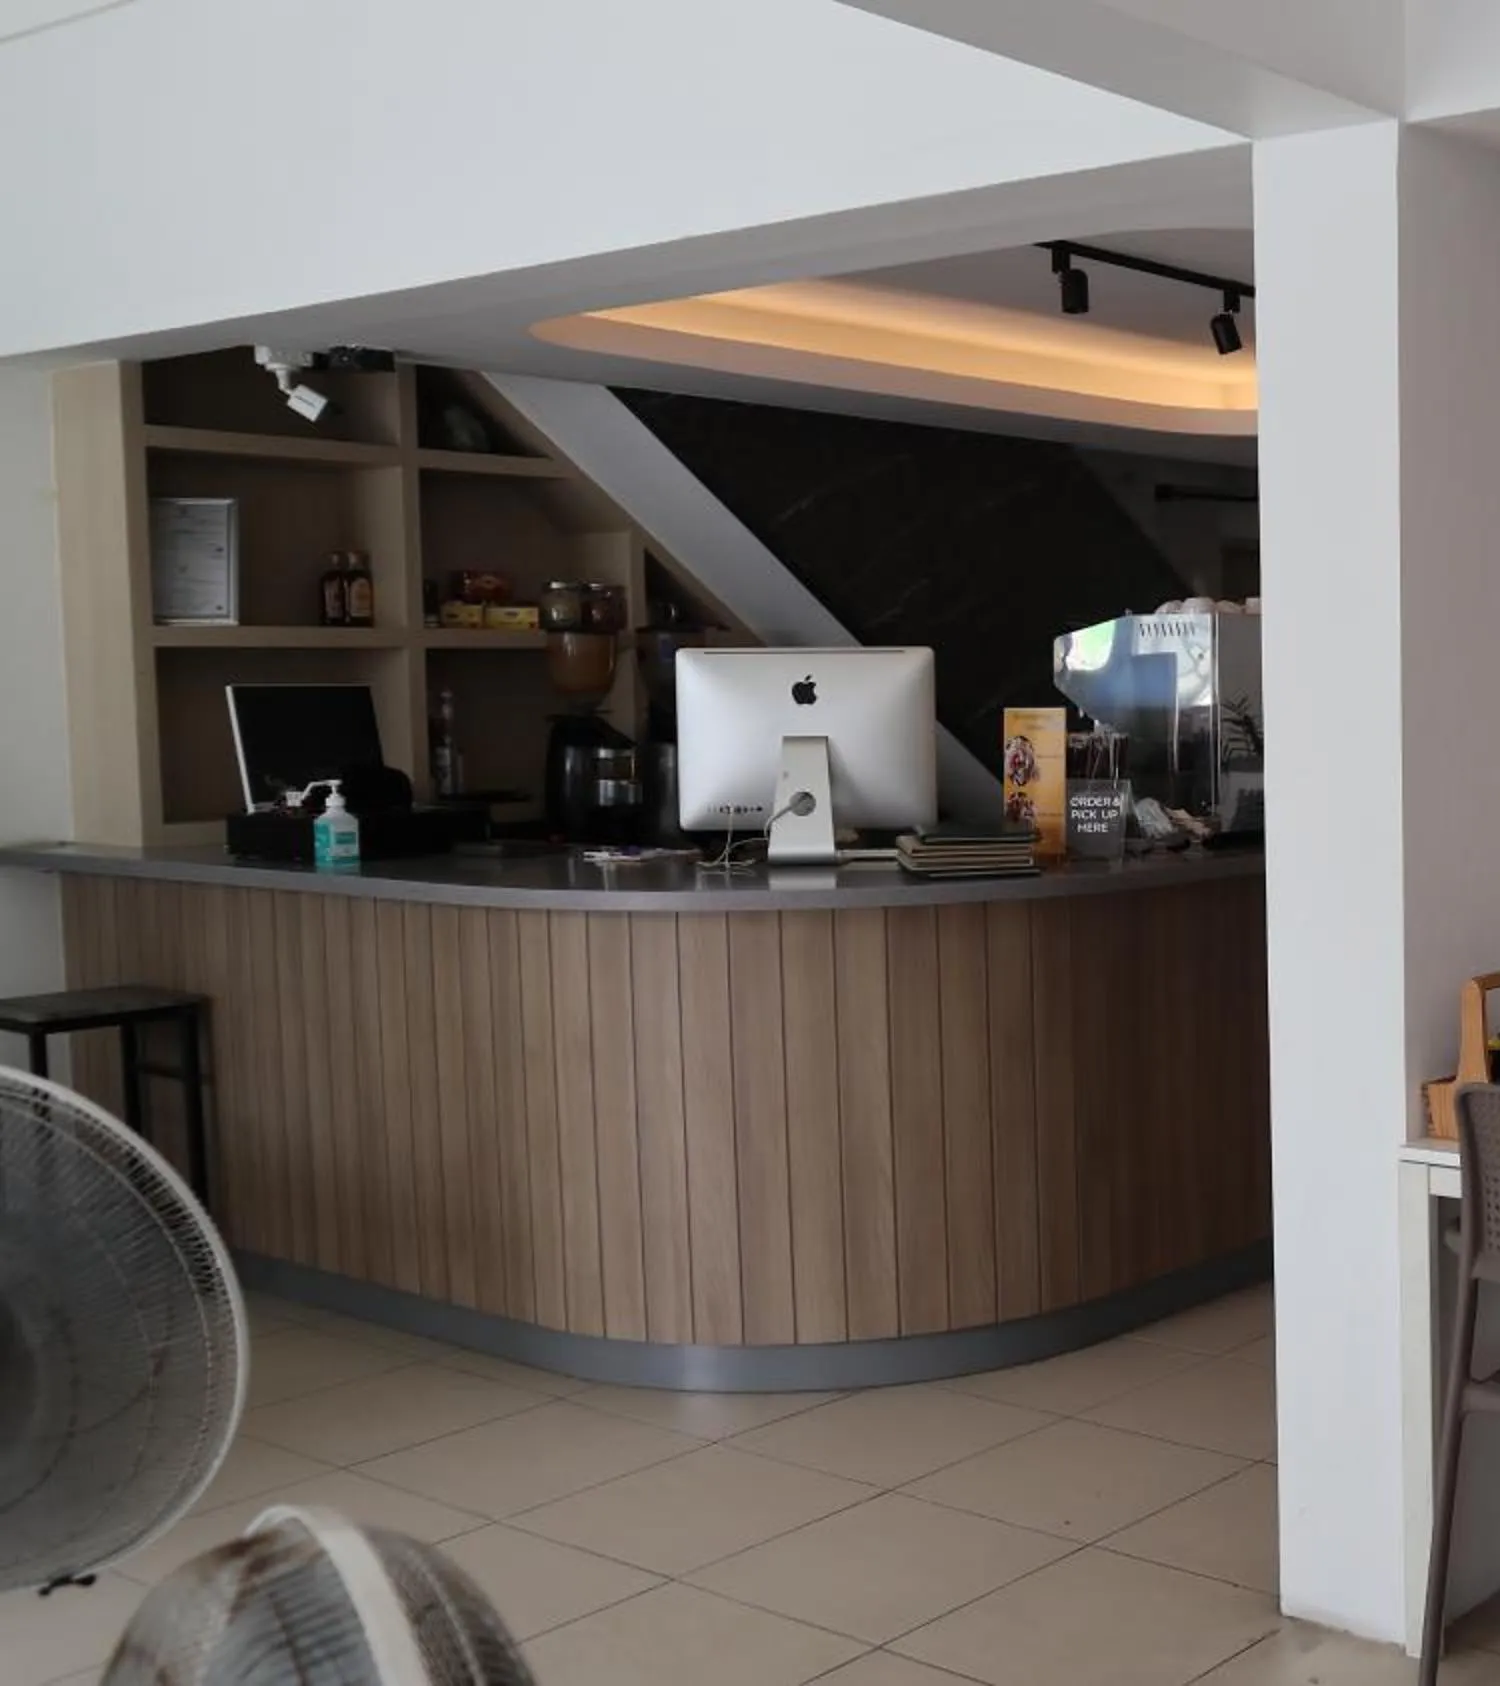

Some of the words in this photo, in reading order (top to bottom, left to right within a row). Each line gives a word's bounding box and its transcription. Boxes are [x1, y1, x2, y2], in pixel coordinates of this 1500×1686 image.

[1070, 796, 1111, 807] ORDER
[1071, 809, 1097, 819] PICK
[1101, 809, 1118, 819] UP
[1077, 822, 1108, 833] HERE
